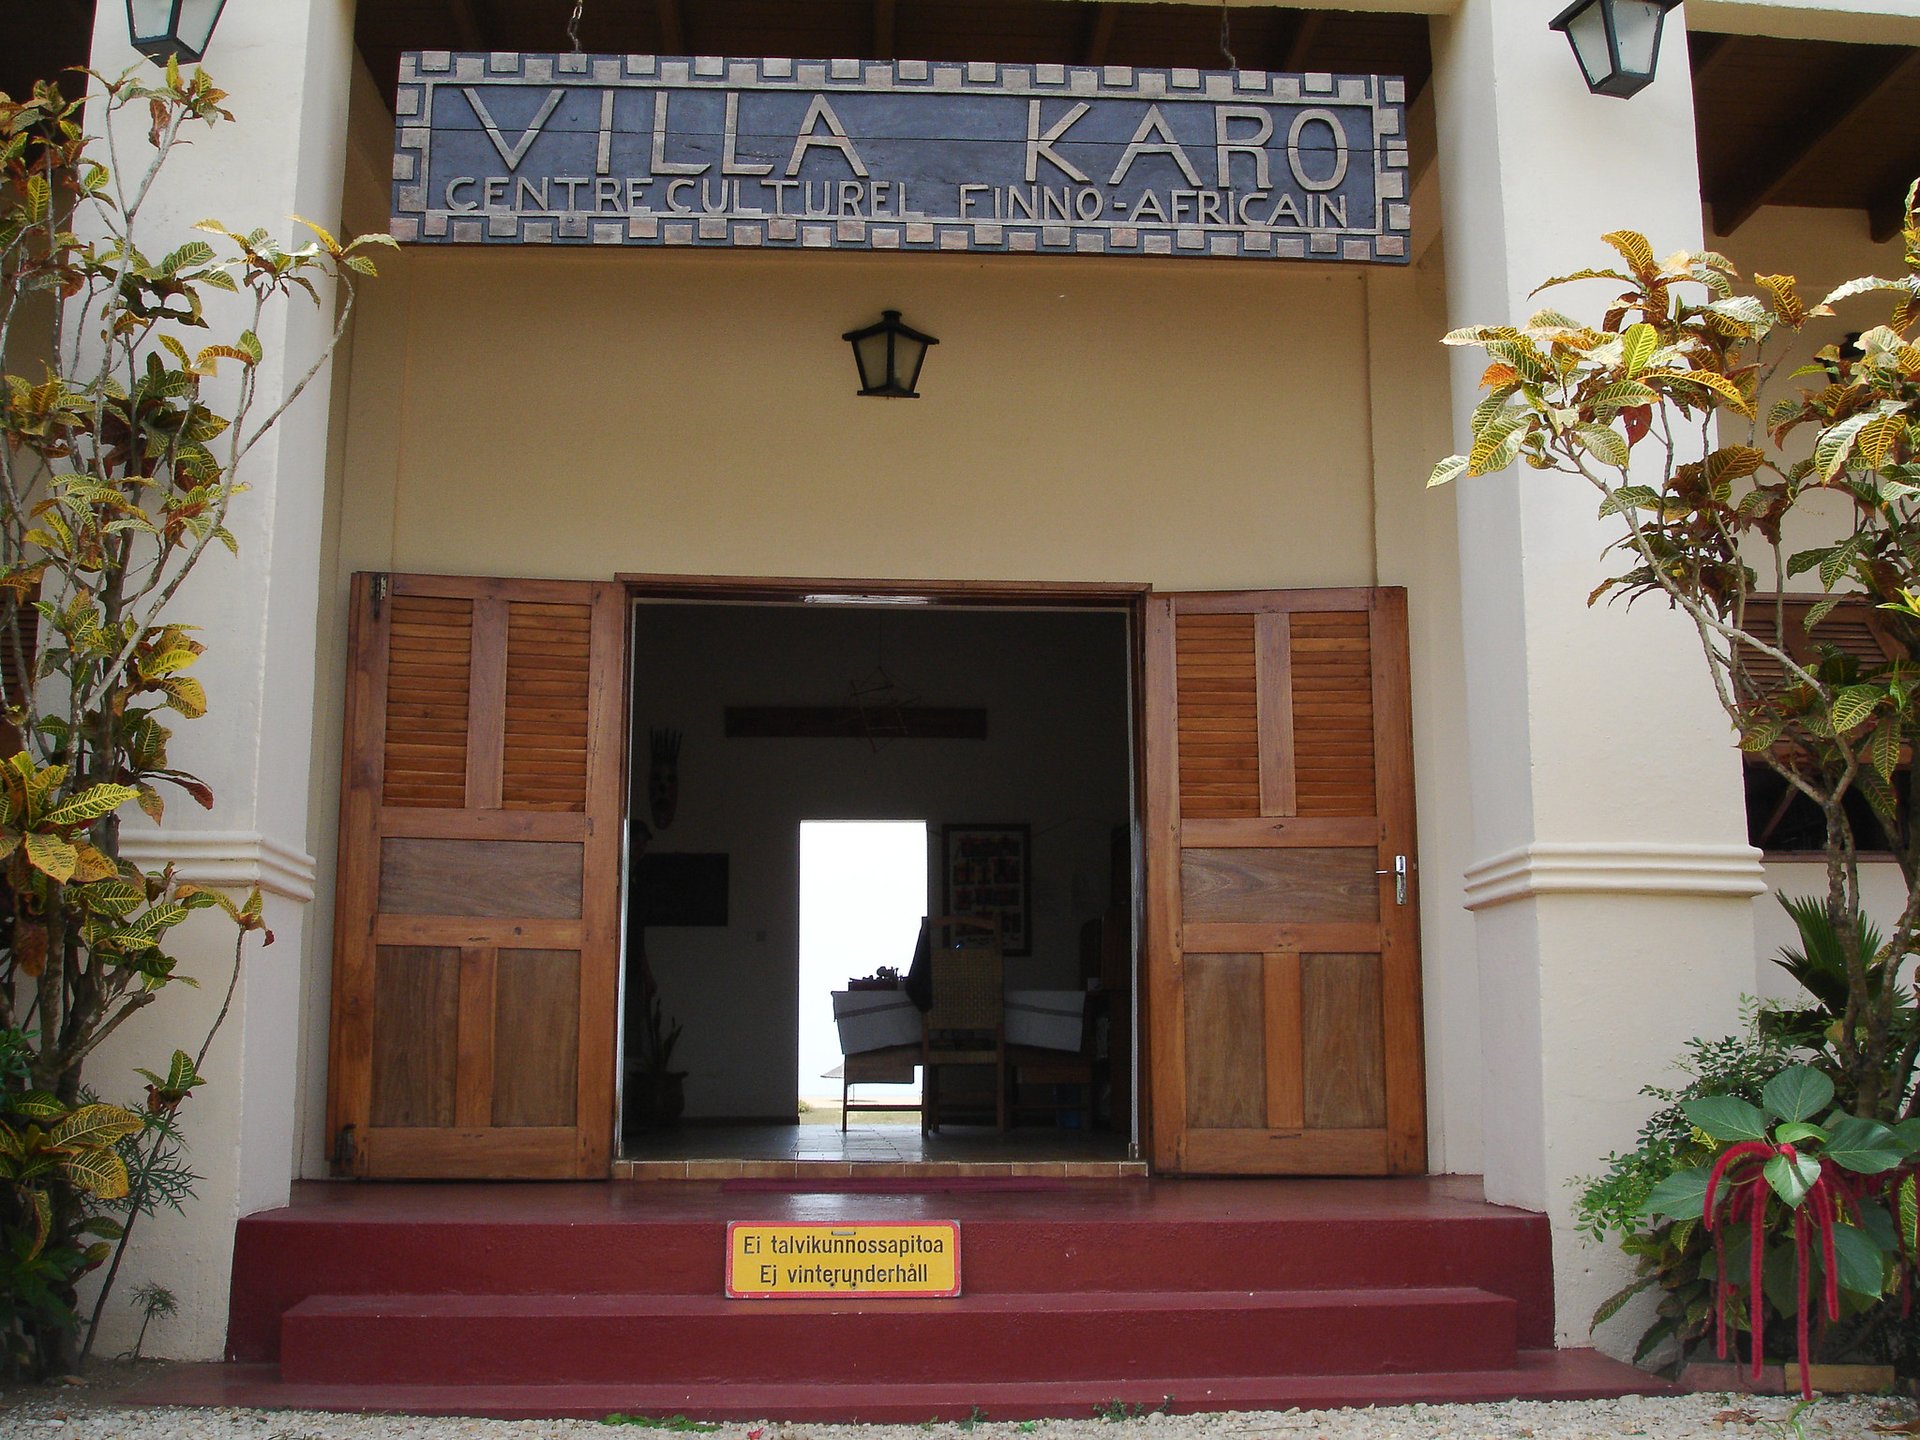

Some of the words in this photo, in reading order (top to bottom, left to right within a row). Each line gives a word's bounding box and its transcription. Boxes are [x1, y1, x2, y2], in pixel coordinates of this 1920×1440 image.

[463, 88, 868, 177] VILLA
[1024, 99, 1348, 191] KARO
[446, 177, 653, 213] CENTRE
[665, 179, 925, 217] CULTUREL
[743, 1236, 760, 1254] Ei
[771, 1235, 943, 1257] talvikunnossapitoa
[760, 1265, 777, 1286] Ej
[787, 1263, 927, 1283] vinterunderhåll
